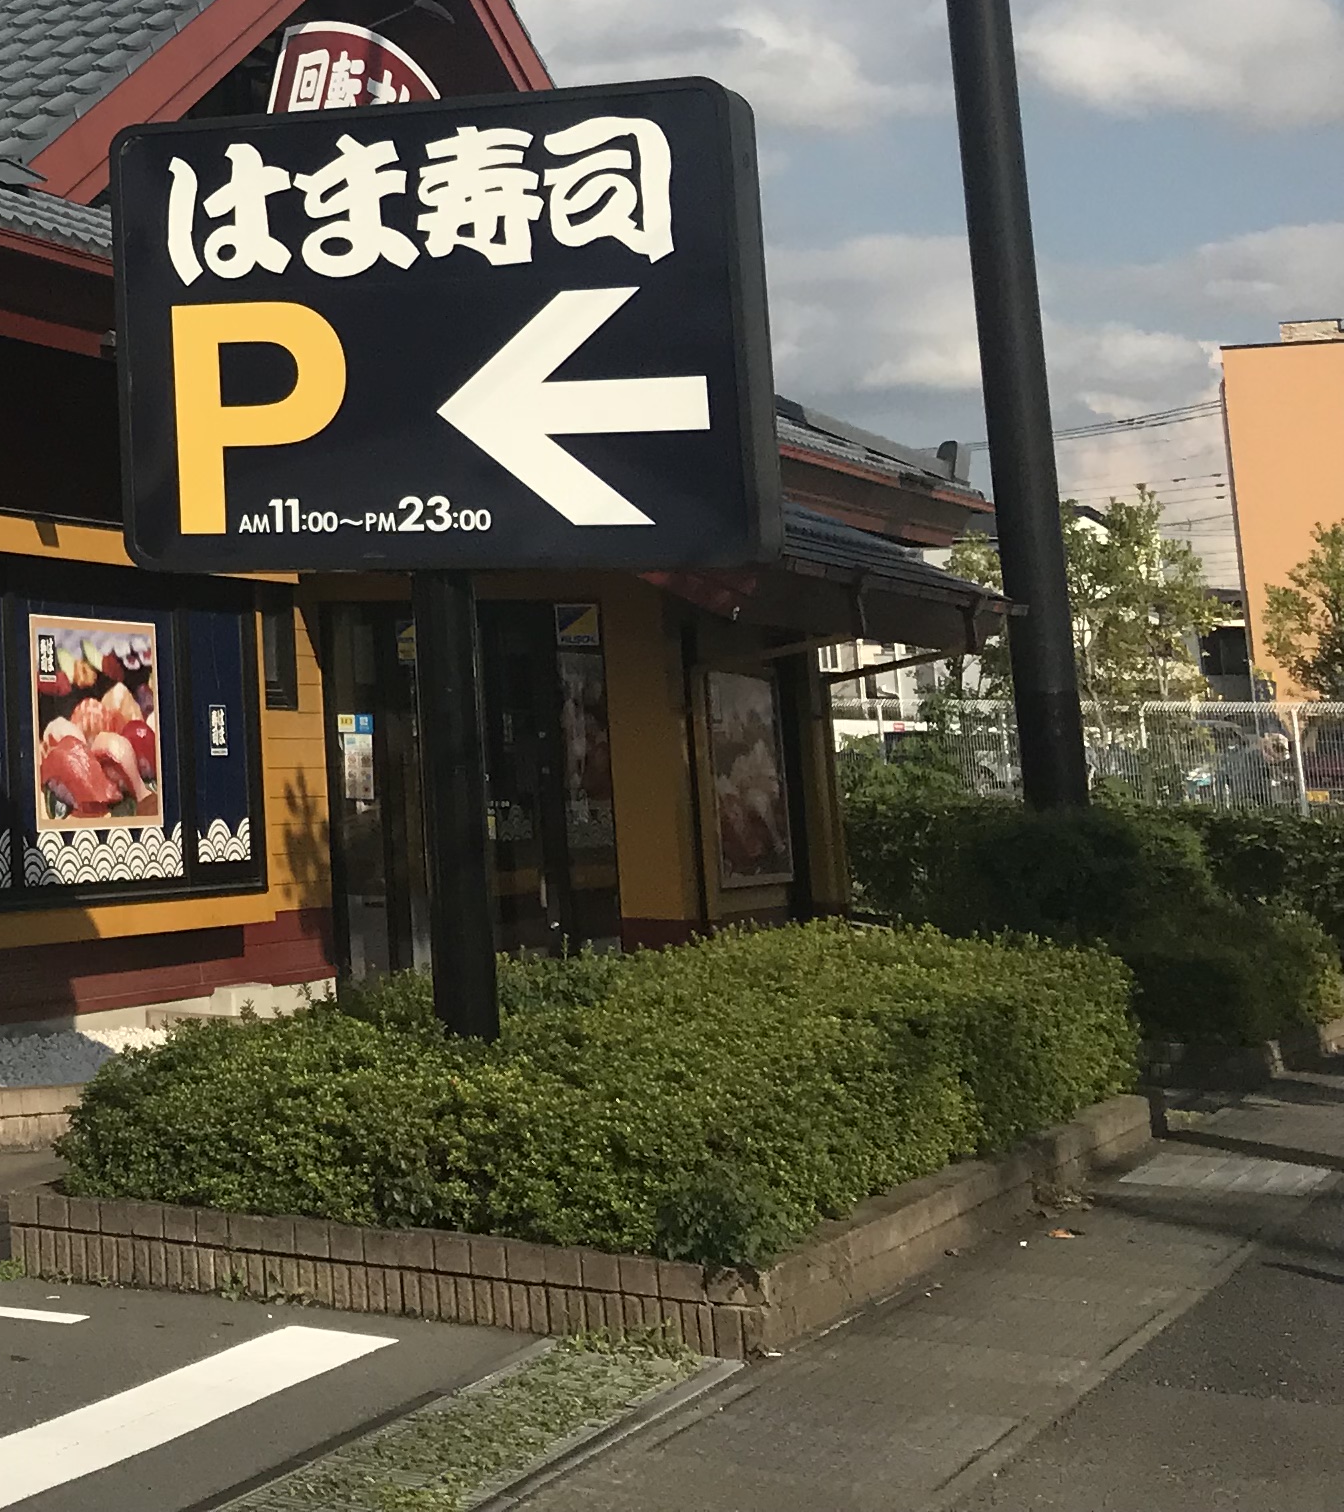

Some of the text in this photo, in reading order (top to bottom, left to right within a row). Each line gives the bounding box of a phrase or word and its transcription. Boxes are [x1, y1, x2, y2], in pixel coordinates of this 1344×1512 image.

[167, 116, 675, 285] はま寿司
[171, 301, 346, 535] P
